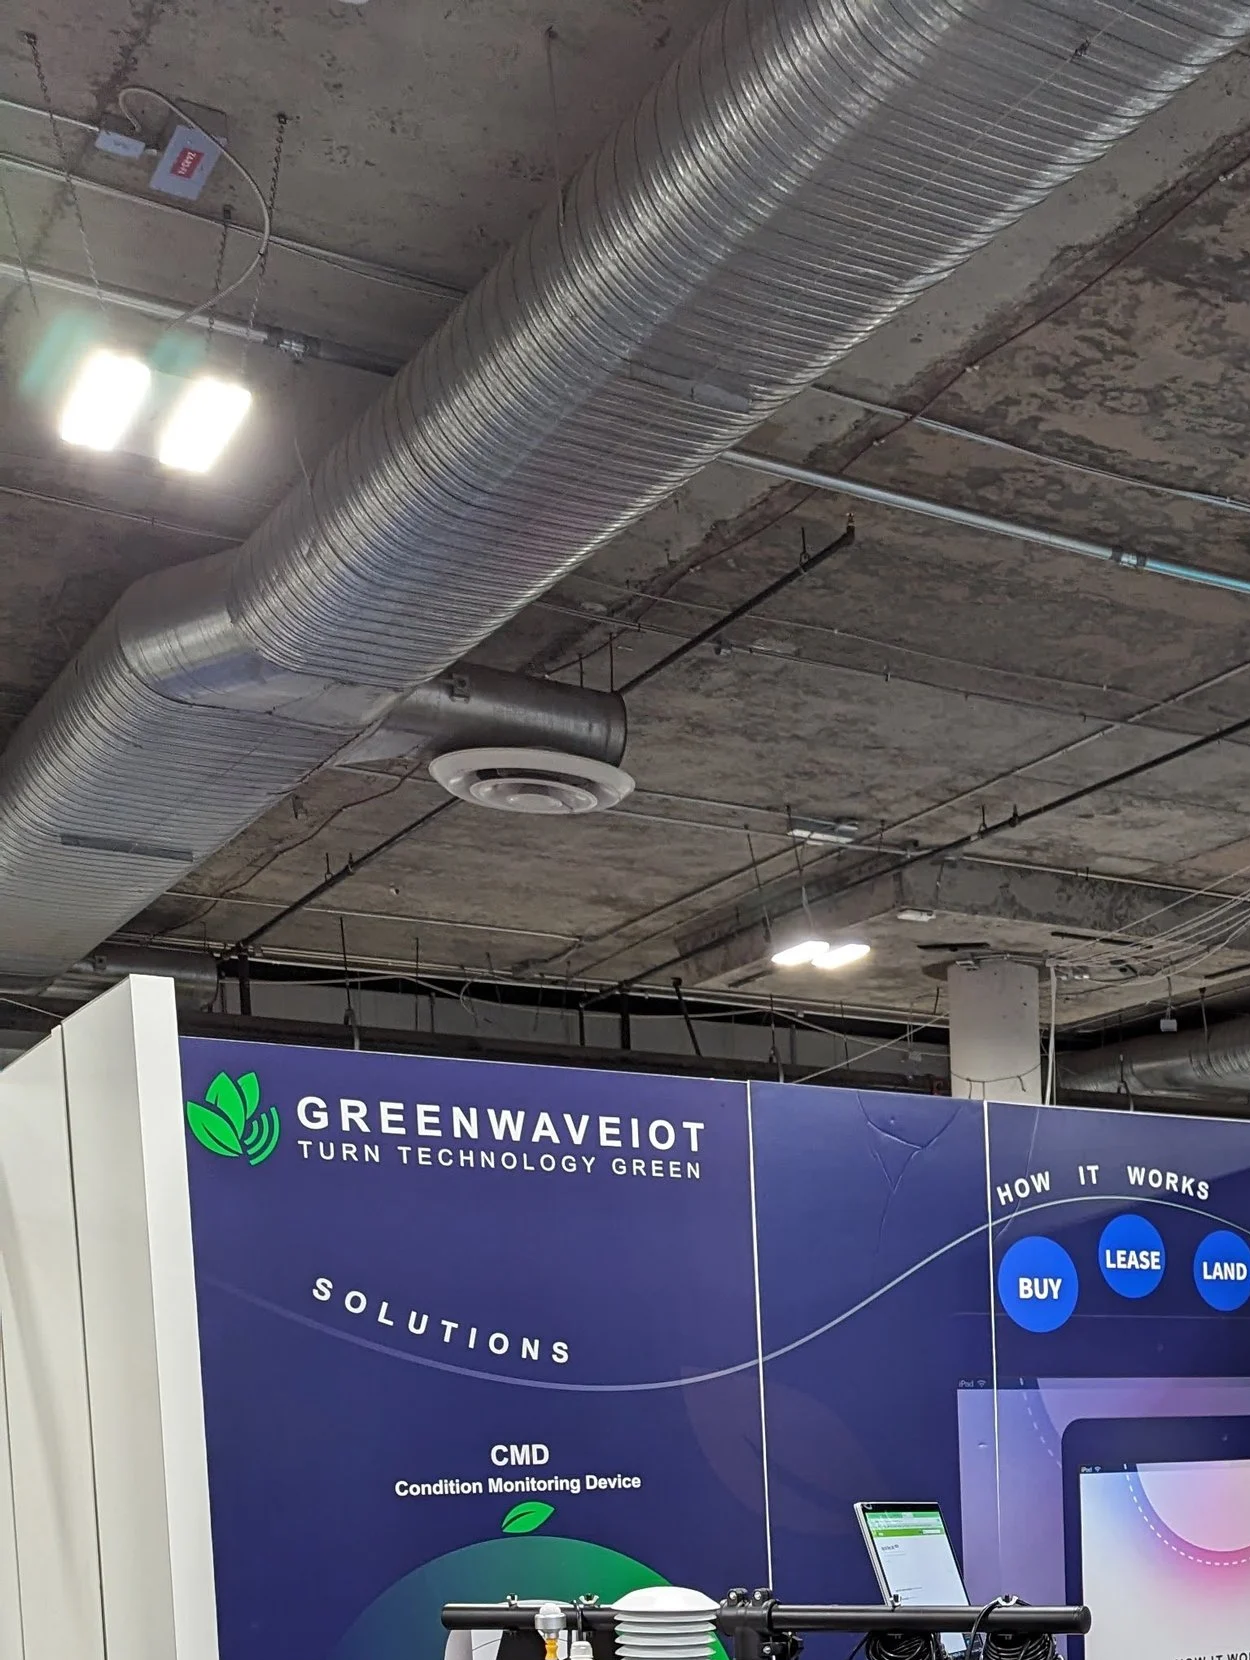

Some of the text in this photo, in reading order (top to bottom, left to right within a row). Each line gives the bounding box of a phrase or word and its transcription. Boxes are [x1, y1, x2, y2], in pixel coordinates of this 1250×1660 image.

[296, 1095, 705, 1153] GREENWAVEIOT
[297, 1140, 702, 1180] TURN TECHNOLOGY GREEN
[996, 1165, 1210, 1205] HOW IT WORKS
[1105, 1249, 1161, 1270] LEASE
[1202, 1261, 1248, 1281] LAND
[1018, 1277, 1062, 1300] BUY
[311, 1277, 571, 1365] SOLUTIONS
[491, 1444, 549, 1466] CMD
[395, 1473, 642, 1497] Condition Monitoring Device
